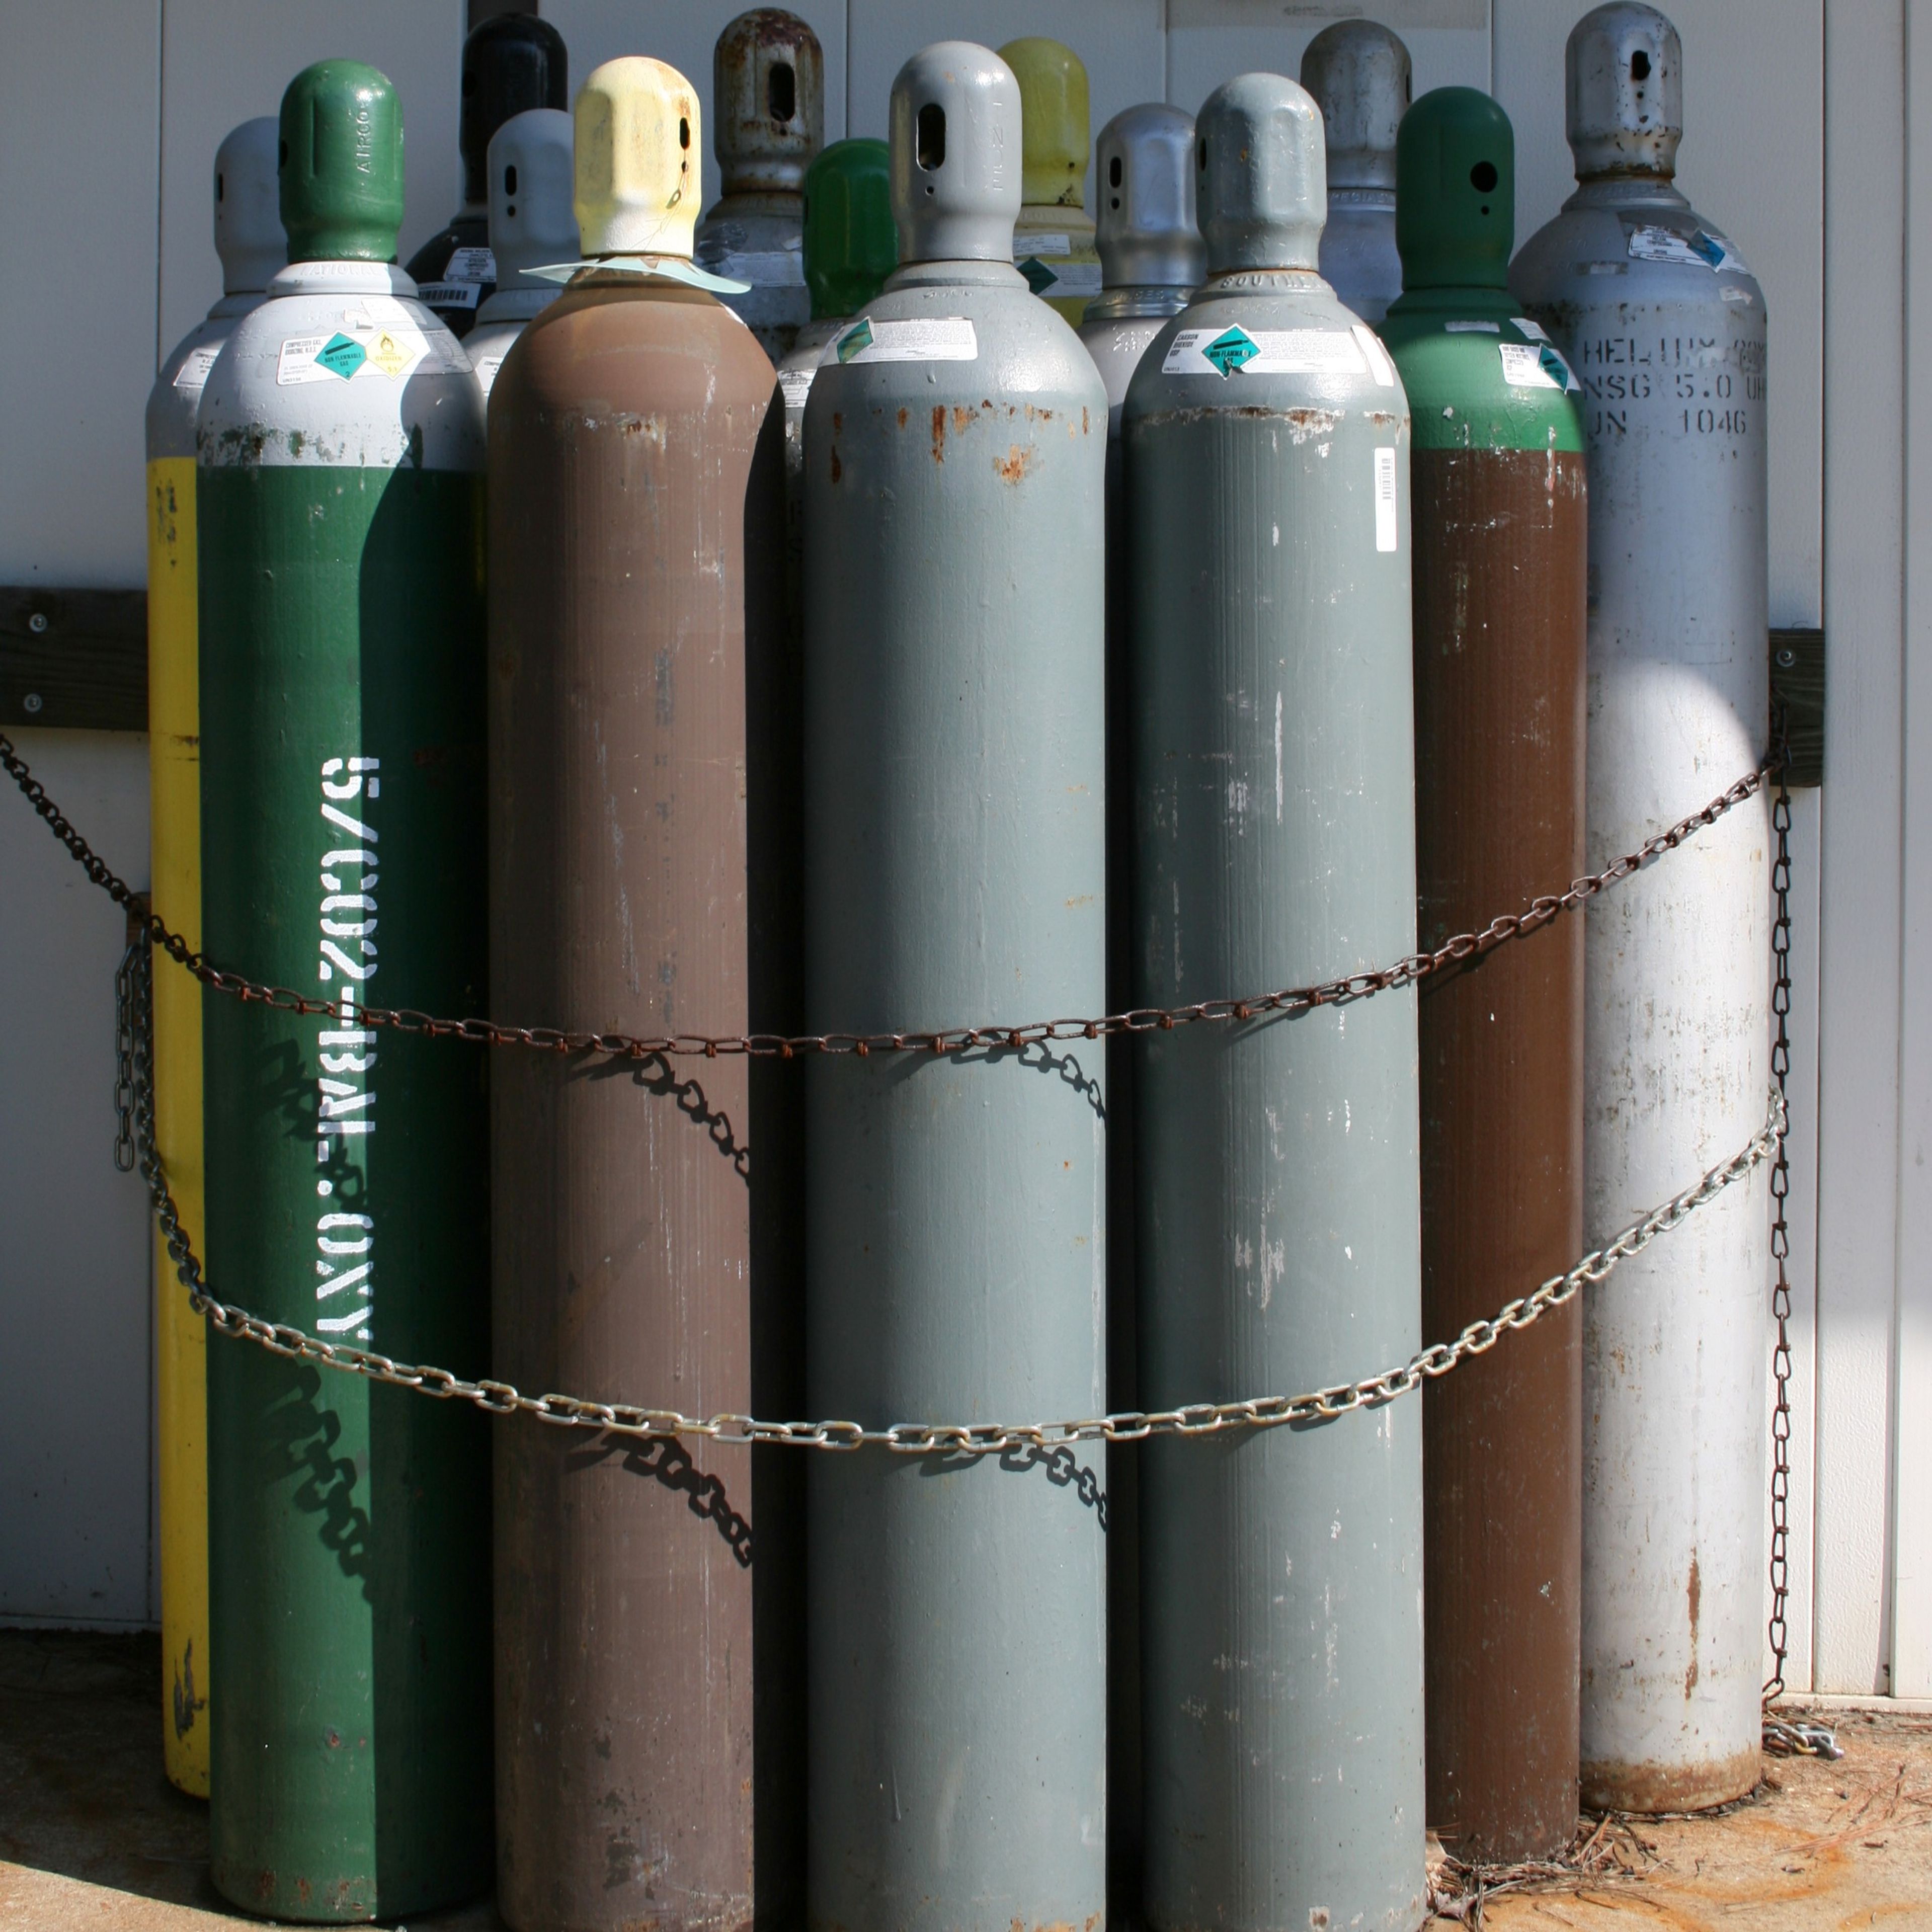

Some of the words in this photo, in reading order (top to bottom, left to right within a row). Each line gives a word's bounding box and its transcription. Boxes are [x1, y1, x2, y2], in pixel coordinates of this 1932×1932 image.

[356, 110, 371, 173] AIRCO
[335, 353, 361, 361] FLAMMABLE
[1584, 374, 1651, 399] NSG
[1677, 374, 1731, 398] 5.0
[1678, 409, 1746, 434] 1046
